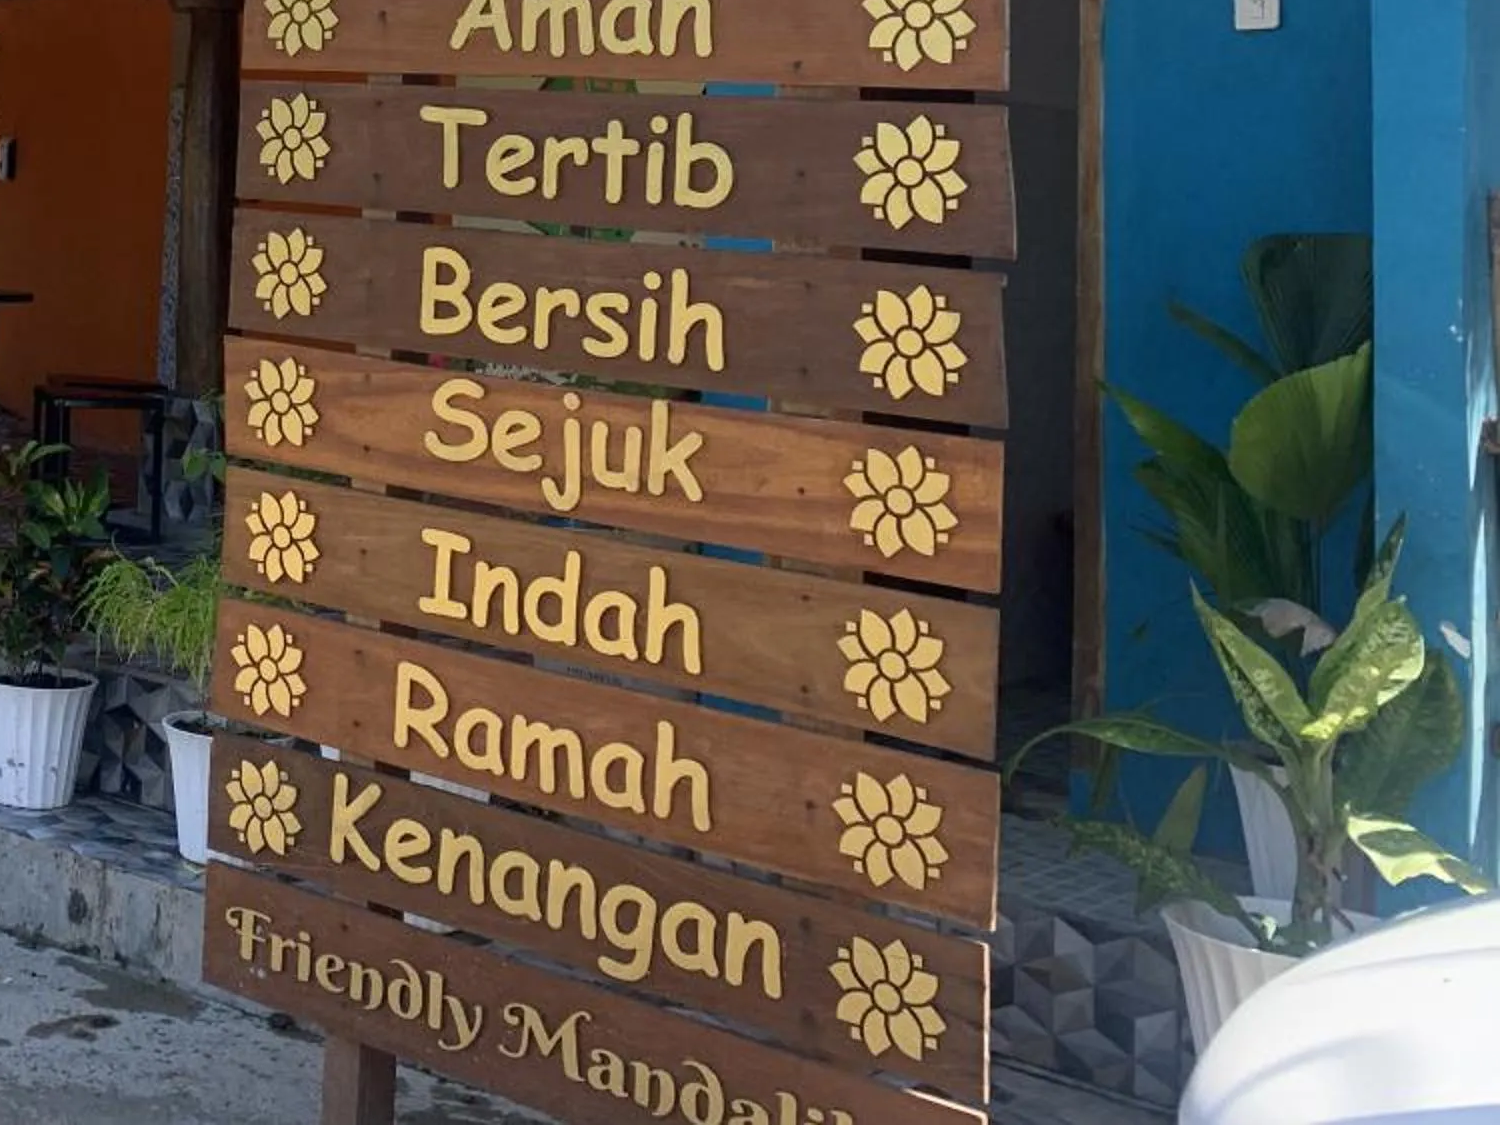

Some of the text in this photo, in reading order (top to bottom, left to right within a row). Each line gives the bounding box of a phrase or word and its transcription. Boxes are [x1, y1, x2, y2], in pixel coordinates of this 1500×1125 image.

[420, 106, 733, 208] Tertib
[420, 247, 724, 372] Bersih
[424, 378, 703, 511] Sejuk
[418, 528, 702, 675] Indah
[393, 661, 710, 832] Ramah
[330, 773, 782, 999] Kenangan
[225, 906, 484, 1052] Friendly
